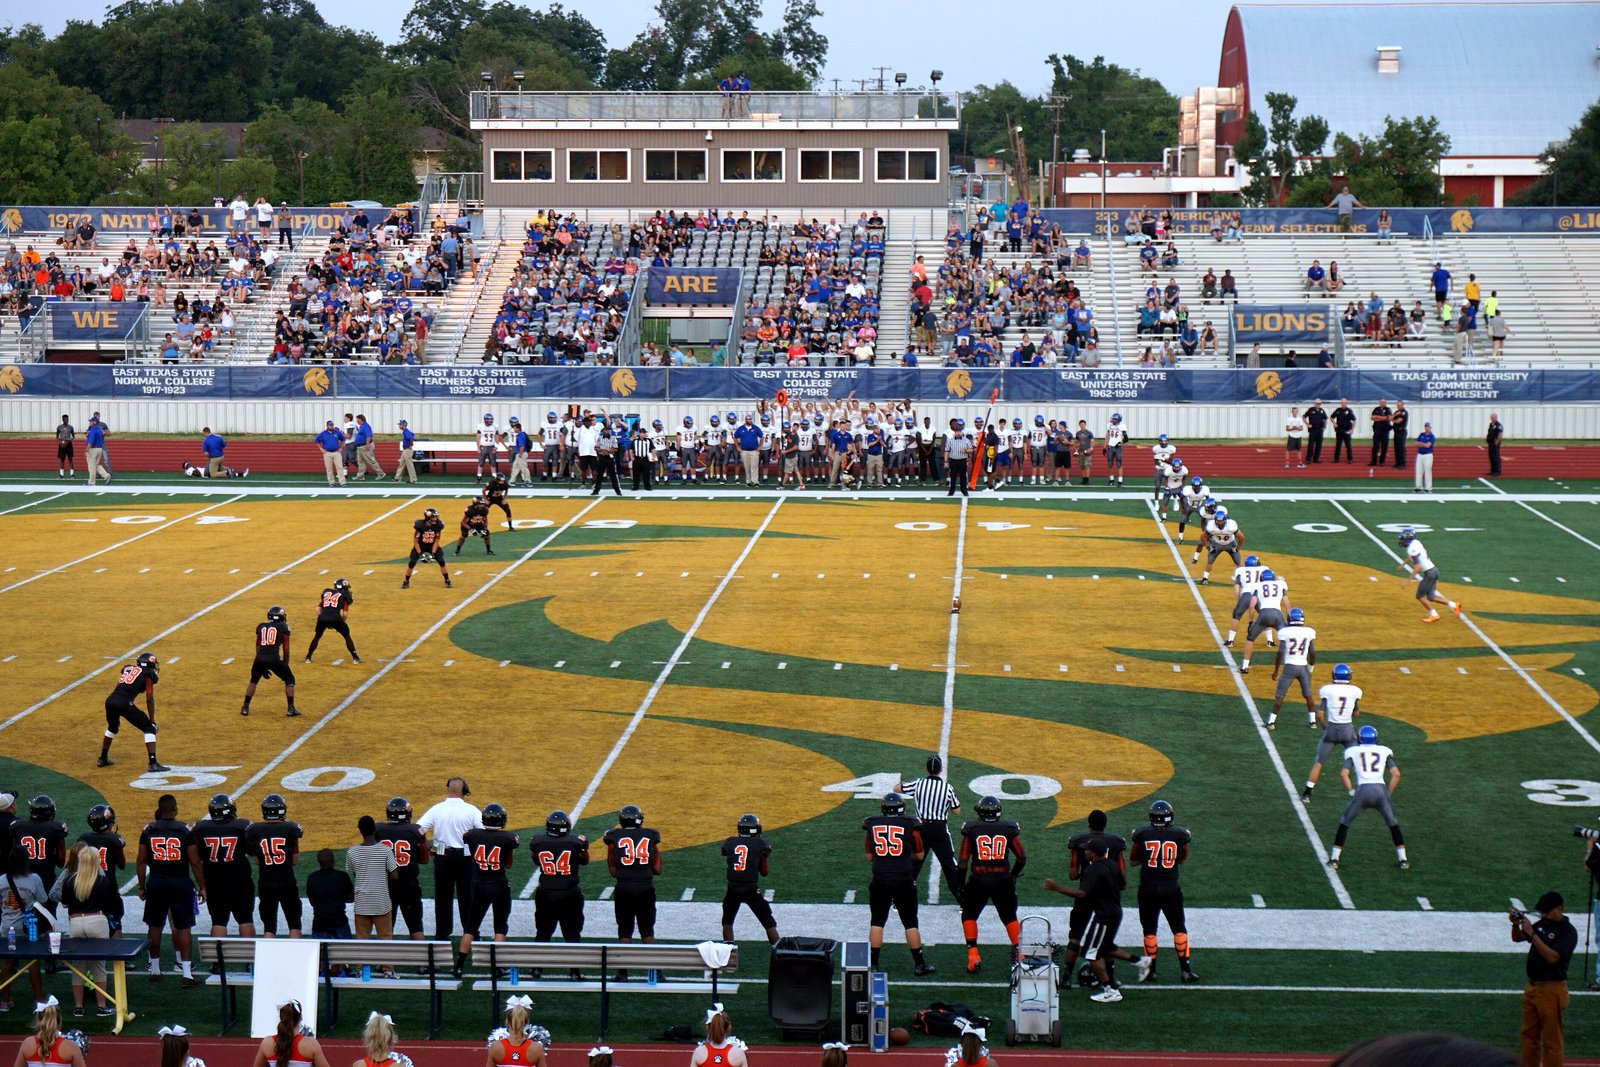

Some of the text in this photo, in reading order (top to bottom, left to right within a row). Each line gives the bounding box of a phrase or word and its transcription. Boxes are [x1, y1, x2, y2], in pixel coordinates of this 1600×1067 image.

[1095, 224, 1120, 234] 300
[1280, 224, 1367, 233] SELECTINS
[663, 275, 718, 293] ARE
[72, 311, 119, 329] WE
[1235, 313, 1326, 332] LIONS
[112, 368, 215, 377] EAST TEXAS STATE
[420, 368, 524, 377] EAST TEXAS STATE
[753, 370, 858, 379] EAST TEXAS STATE
[1061, 371, 1167, 380] EAST TEXAS STATE
[1391, 372, 1529, 381] TEXAS A&M UNIVERSITY
[114, 377, 214, 386] NORMAL COLLEGE
[417, 377, 527, 386] TEACHERS COLLEGE
[783, 379, 832, 388] COLLEGE
[1080, 381, 1148, 389] UNIVERSITY
[1426, 381, 1494, 390] COMMERCE
[142, 386, 186, 394] 1917-1923
[449, 386, 496, 395] 1923-1957
[783, 388, 829, 396] 957-1962
[1089, 389, 1138, 398] 1962-1996
[1420, 390, 1500, 399] 1996-PRESENT
[1012, 435, 1022, 445] 27
[1245, 570, 1260, 583] 31
[1262, 584, 1279, 598] 83
[323, 591, 342, 607] 24
[260, 626, 277, 645] 10
[1289, 637, 1307, 656] 24
[1338, 696, 1347, 716] 7
[1359, 752, 1380, 772] 12
[21, 836, 46, 859] 31
[872, 825, 904, 856] 55
[976, 835, 1007, 860] 60
[150, 837, 181, 861] 56
[204, 836, 238, 862] 77
[260, 837, 286, 865] 15
[618, 837, 650, 866] 34
[1145, 840, 1178, 868] 70
[474, 844, 501, 871] 44
[538, 850, 572, 875] 64
[733, 845, 749, 872] 3
